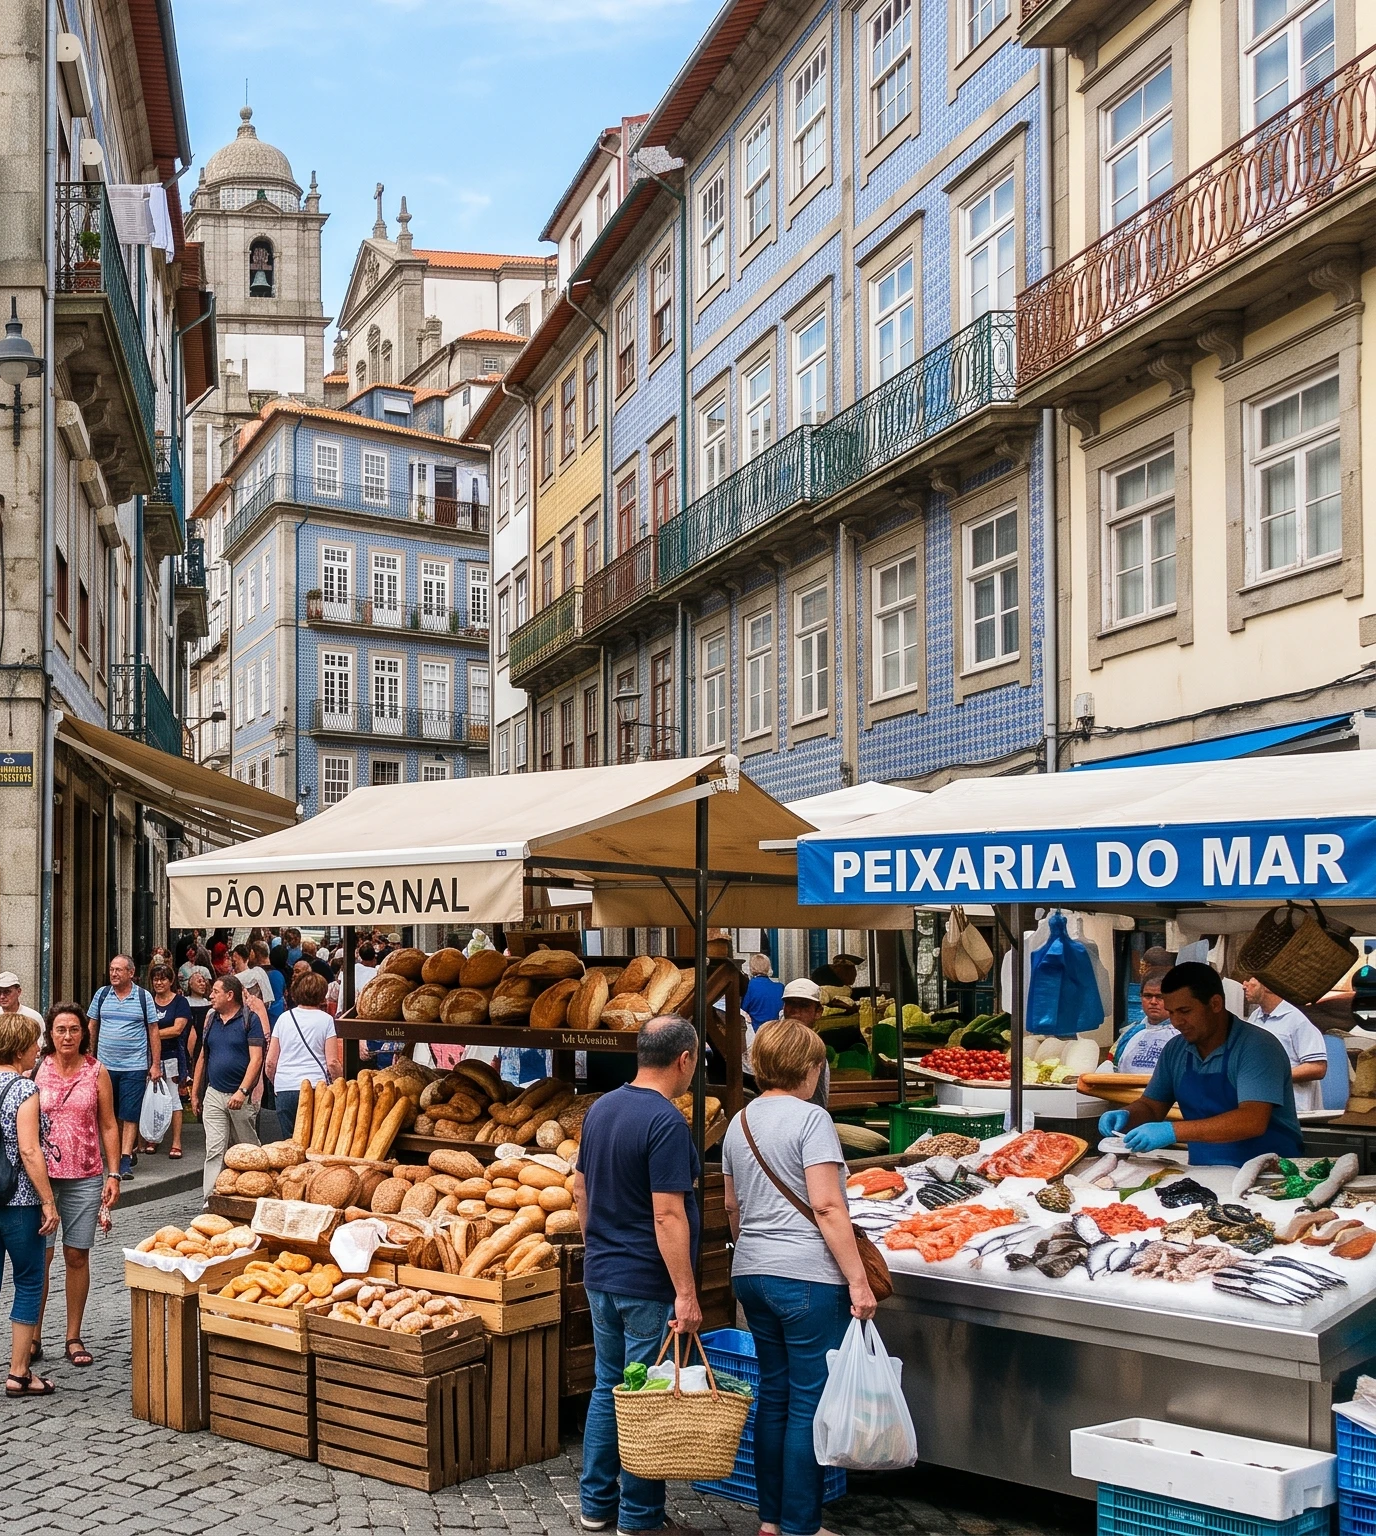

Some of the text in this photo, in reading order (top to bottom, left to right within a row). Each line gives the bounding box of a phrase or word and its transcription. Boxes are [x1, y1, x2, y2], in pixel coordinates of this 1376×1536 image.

[832, 833, 1348, 893] PEIXARIA DO MAR
[205, 876, 471, 919] PÃO ARTESANAL
